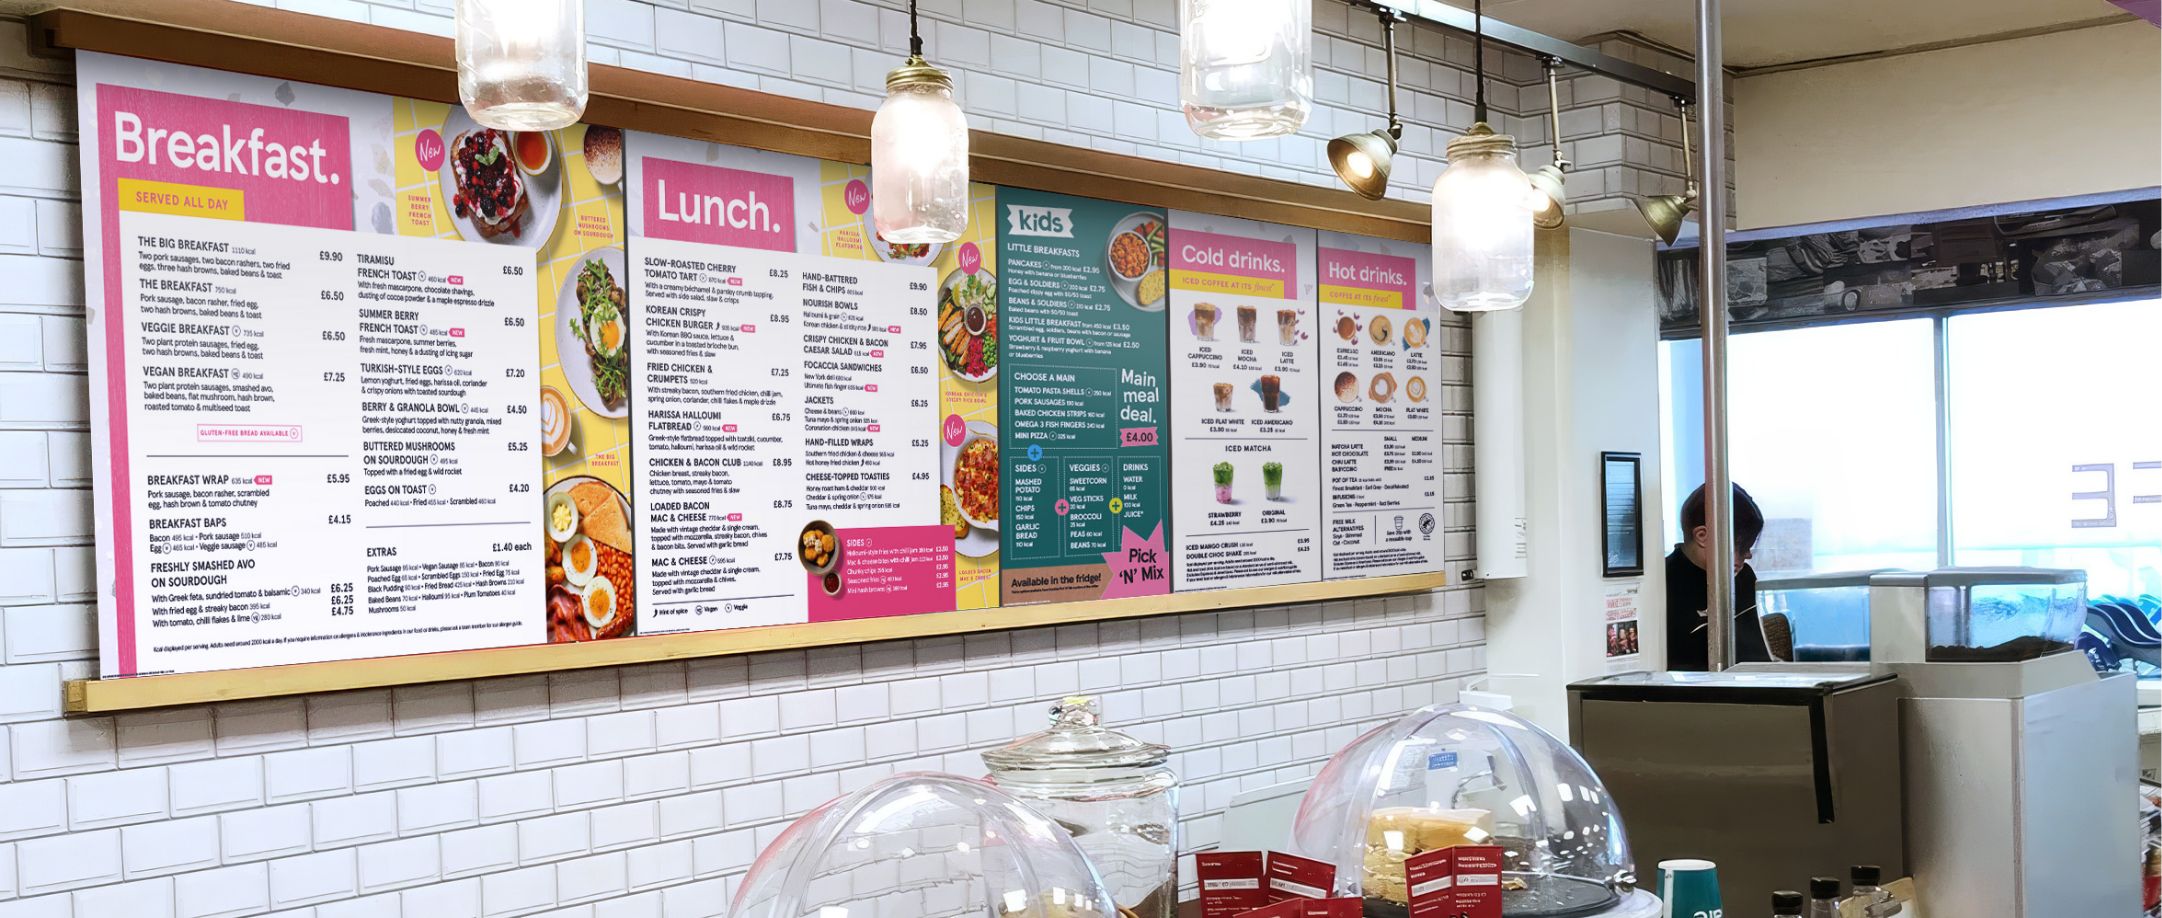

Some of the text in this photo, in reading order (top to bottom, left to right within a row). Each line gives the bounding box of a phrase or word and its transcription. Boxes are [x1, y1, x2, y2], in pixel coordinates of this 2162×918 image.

[114, 111, 340, 185] Breakfast.
[420, 140, 441, 161] New
[136, 192, 228, 209] SERVED ALL DAY
[658, 179, 781, 233] Lunch.
[1018, 210, 1063, 232] kids
[138, 236, 229, 252] THE BIG BREAKFAST
[1008, 243, 1080, 257] LITTLE BREAKFASTS
[138, 251, 152, 260] Two
[153, 254, 169, 262] pork
[170, 255, 201, 265] sausages,
[215, 257, 236, 266] bacon
[236, 260, 262, 268] rashers,
[262, 261, 275, 269] two
[275, 261, 290, 270] fried
[320, 251, 343, 261] £9.90
[357, 254, 394, 265] TIRAMISU
[1182, 245, 1285, 272] Cold drinks.
[644, 257, 736, 272] SLOW-ROASTED CHERRY
[1008, 259, 1042, 268] PANCAKES
[358, 268, 417, 281] FRENCH TOAST
[503, 266, 523, 275] £6.50
[644, 269, 698, 281] TOMATO TART
[769, 269, 788, 278] £8.25
[1329, 262, 1407, 285] Hot drinks.
[803, 272, 858, 284] HAND-BATTERED
[1182, 277, 1200, 286] ICED
[1202, 279, 1230, 288] COFFEE
[139, 279, 213, 292] THE BREAKFAST
[803, 283, 817, 291] FISH
[826, 285, 846, 294] CHIPS
[910, 282, 927, 291] £9.90
[321, 290, 344, 301] £6.50
[359, 309, 419, 320] SUMMER BERRY
[646, 305, 706, 316] KOREAN CRISPY
[504, 317, 524, 327] £6.50
[770, 314, 789, 323] £8.95
[141, 322, 230, 335] VEGGIE BREAKFAST
[646, 318, 713, 330] CHICKEN BURGER
[322, 331, 345, 341] £6.50
[143, 366, 229, 378] VEGAN BREAKFAST
[360, 363, 443, 375] TURKISH-STYLE EGGS
[506, 368, 525, 377] £7.20
[647, 362, 669, 371] FRIED
[671, 364, 705, 373] CHICKEN
[771, 368, 789, 376] £7.25
[324, 372, 345, 382] £7.25
[647, 374, 688, 384] CRUMPETS
[1014, 372, 1047, 381] CHOOSE
[1056, 374, 1075, 382] MAIN
[1122, 369, 1155, 386] Main
[1014, 386, 1041, 394] TOMATO
[1124, 387, 1159, 402] meal
[362, 402, 387, 411] BERRY
[397, 403, 435, 412] GRANOLA
[437, 403, 460, 412] BOWL
[1034, 398, 1066, 406] SAUSAGES
[507, 405, 527, 414] £4.50
[1120, 406, 1156, 423] deal.
[648, 410, 721, 420] HARISSA HALLOUMI
[772, 413, 790, 421] £6.75
[648, 422, 692, 431] FLATBREAD
[1126, 432, 1153, 442] £4.00
[363, 441, 455, 451] BUTTERED MUSHROOMS
[508, 442, 528, 451] £5.25
[363, 455, 428, 464] ON SOURDOUGH
[1015, 464, 1037, 472] SIDES
[147, 475, 229, 485] BREAKFAST WRAP
[327, 474, 350, 483] £5.95
[806, 473, 859, 481] CHEESE-TOPPED
[912, 472, 929, 480] £4.95
[365, 485, 427, 495] EGGS ON TOAST
[509, 484, 529, 492] £4.20
[650, 502, 710, 511] LOADED BACON
[774, 500, 792, 508] £8.75
[328, 514, 351, 524] £4.15
[651, 514, 668, 522] MAC
[677, 513, 706, 522] CHEESE
[149, 518, 226, 529] BREAKFAST BAPS
[493, 542, 532, 552] £1.40 each
[847, 539, 864, 547] SIDES
[367, 547, 397, 557] EXTRAS
[1129, 548, 1157, 563] Pick
[151, 559, 255, 572] FRESHLY SMASHED AVO
[151, 575, 227, 588] ON SOURDOUGH
[1011, 573, 1101, 587] Available in the fridge!
[331, 583, 353, 593] £6.25
[331, 595, 353, 605] £6.25
[169, 606, 184, 614] fried
[185, 607, 198, 615] egg
[205, 605, 228, 613] streaky
[332, 606, 354, 616] £4.75
